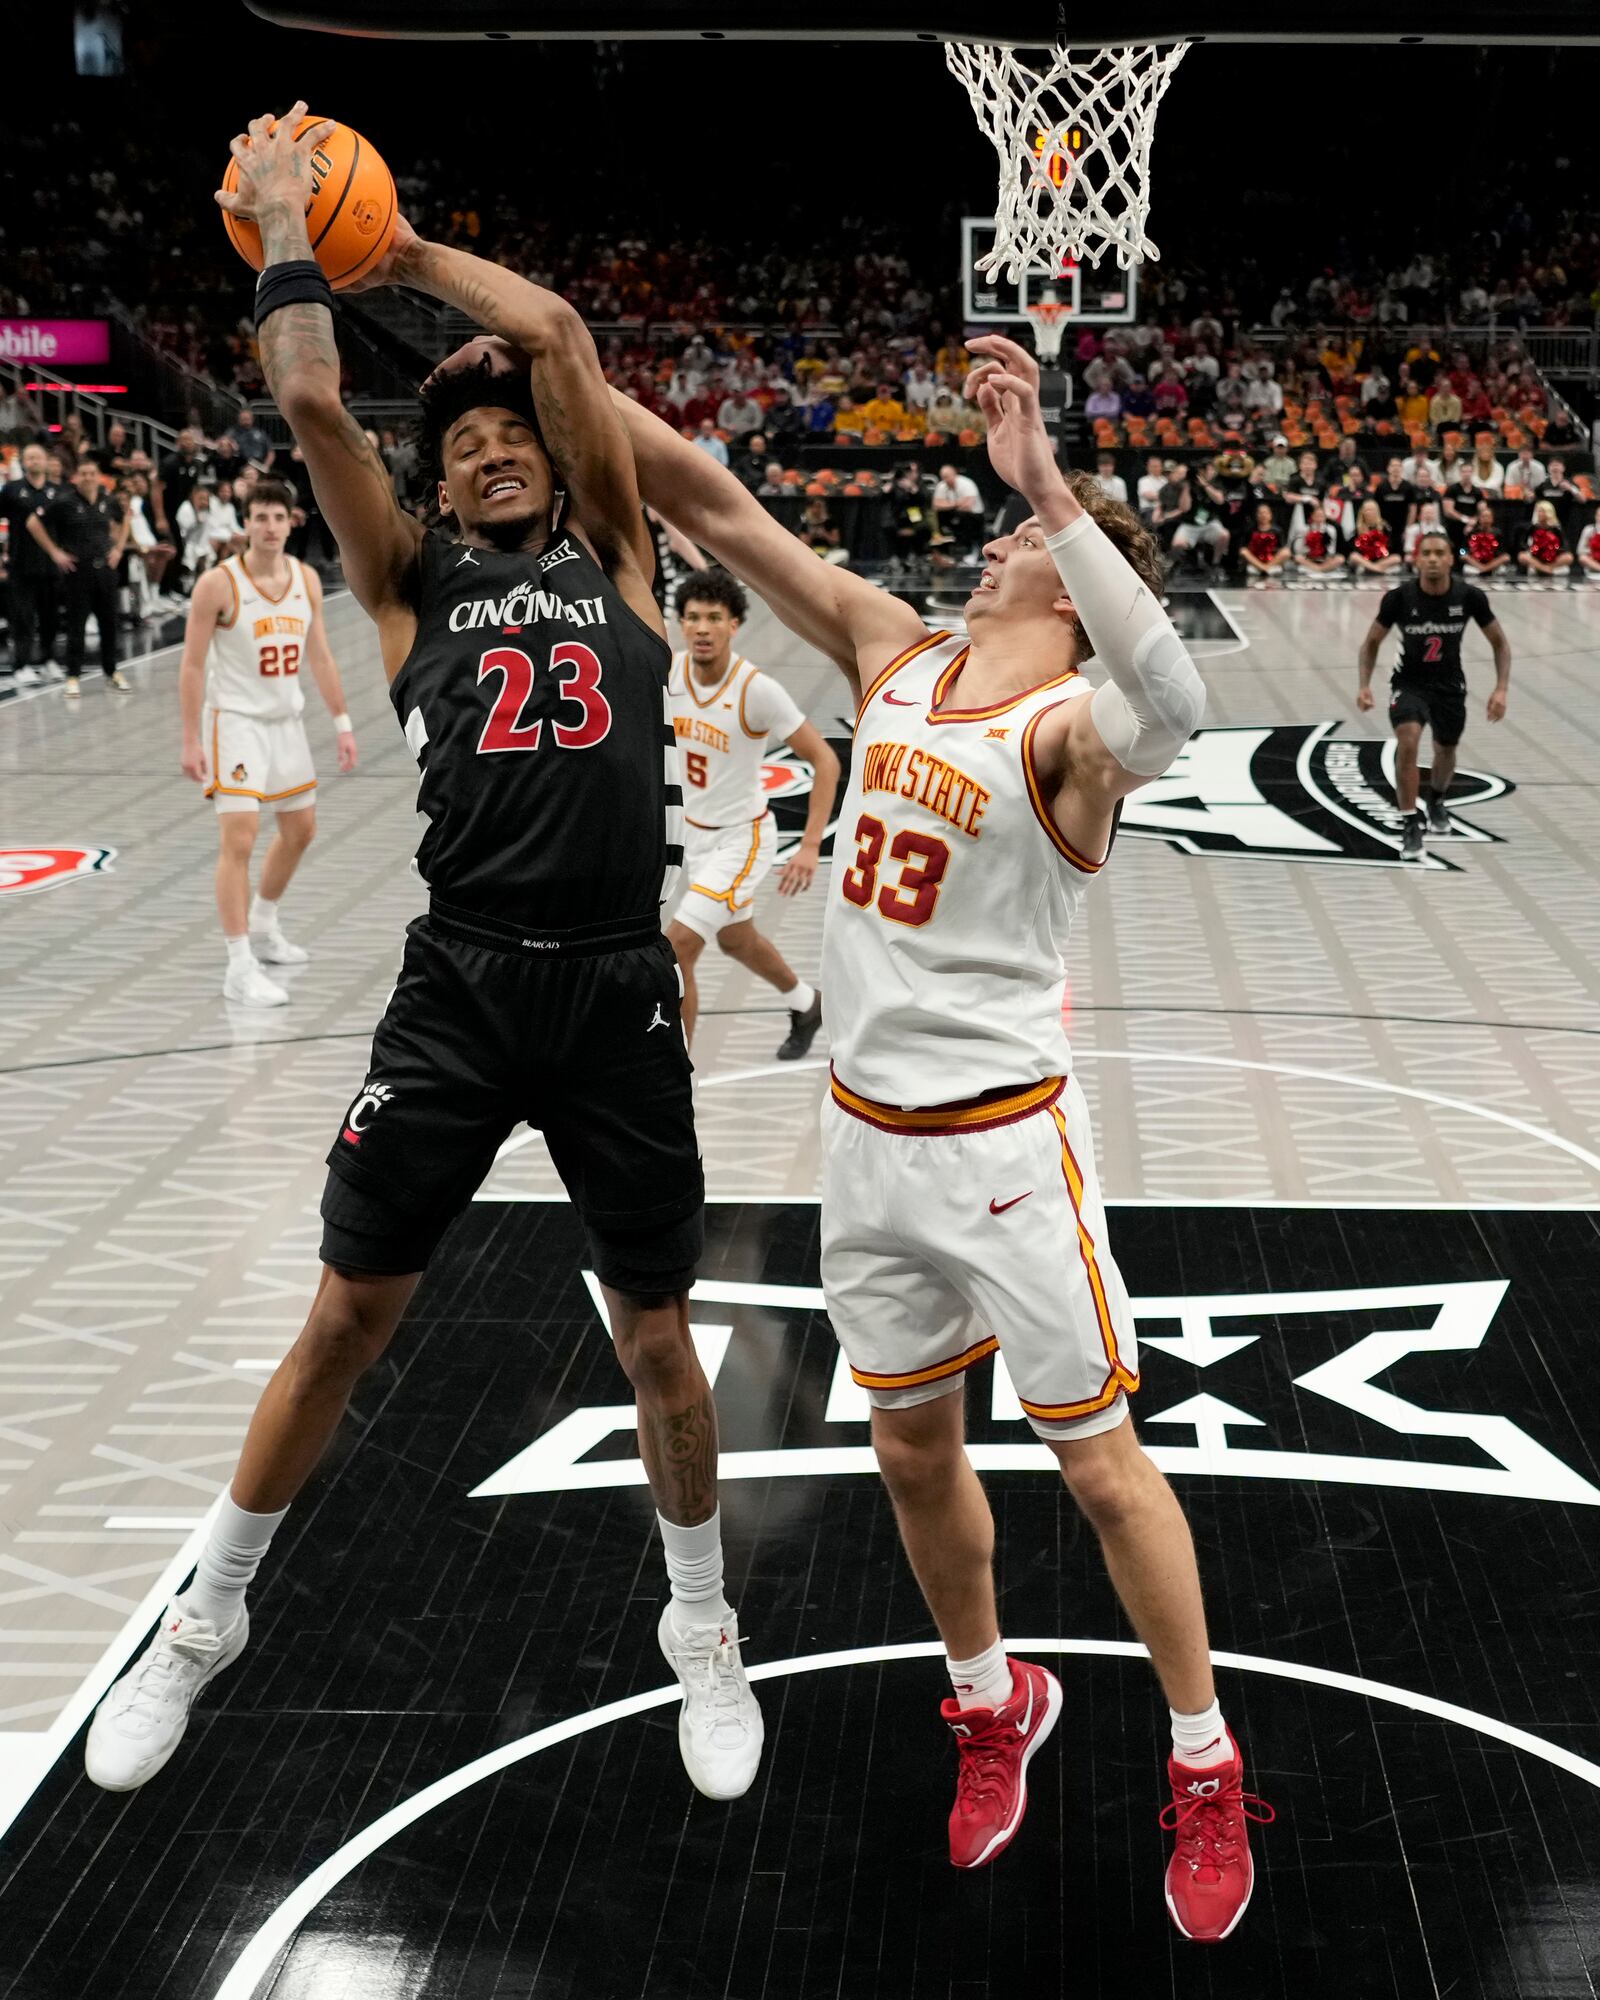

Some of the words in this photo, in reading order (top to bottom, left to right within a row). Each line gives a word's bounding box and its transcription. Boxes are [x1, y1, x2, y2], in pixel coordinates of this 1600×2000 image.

[0, 325, 57, 358] bile
[449, 589, 607, 633] CINCINNATI
[260, 645, 299, 677] 22
[1424, 635, 1443, 662] 2
[476, 641, 612, 755] 23
[686, 751, 707, 790] 5
[862, 741, 908, 796] IOWA
[899, 747, 993, 840] STATE
[842, 811, 951, 929] 33
[522, 939, 560, 949] BEARCATS
